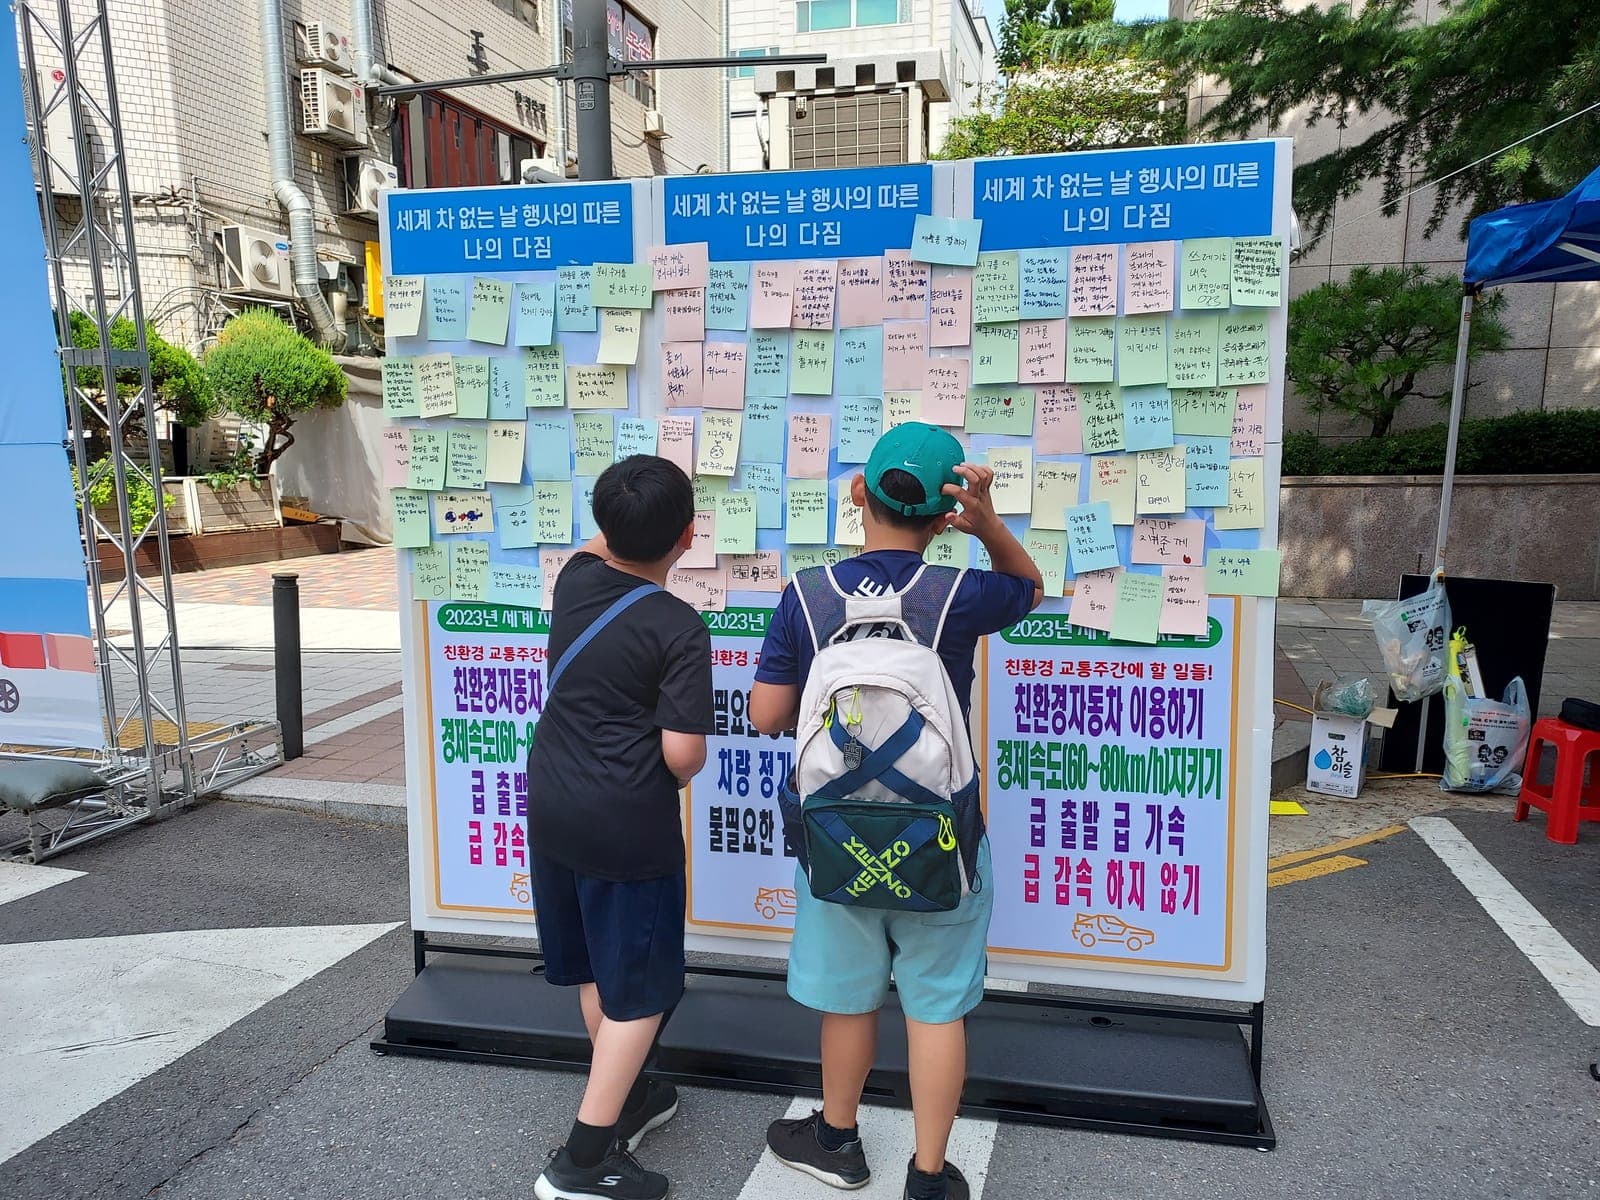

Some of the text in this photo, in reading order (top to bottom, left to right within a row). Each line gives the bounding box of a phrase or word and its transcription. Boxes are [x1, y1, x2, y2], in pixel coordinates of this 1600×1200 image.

[672, 183, 919, 218] 세계 차 없는 날 행사의 따른
[982, 161, 1259, 203] 세계 차 없는 날 행사의 따른
[396, 200, 621, 232] 세계 차 없는 날 행사의 따른
[745, 220, 842, 248] 나의 다짐
[1063, 202, 1172, 233] 나의 다짐
[464, 236, 551, 260] 나의 다짐
[445, 609, 499, 628] 2023년
[708, 612, 765, 632] 2023년
[1008, 619, 1073, 640] 2023년
[443, 645, 484, 661] 친환경
[1004, 659, 1213, 681] 친환경 교통주간에 할 일들!
[453, 666, 543, 715] 친환경자동차
[1014, 683, 1204, 740] 친환경자동차 이용하기
[997, 740, 1223, 800] 경제속도(60~80km/h)지키기
[1331, 744, 1348, 763] 참
[1331, 760, 1354, 779] 이슬
[717, 748, 751, 798] 차량
[471, 770, 486, 815] 급
[468, 820, 525, 868] 급 감속
[709, 806, 774, 856] 불필요한
[1030, 797, 1185, 857] 급 출발 급 가속
[842, 836, 911, 899] KENZO
[845, 840, 911, 898] KENZO
[1024, 853, 1200, 916] 급 감속 하지 않기
